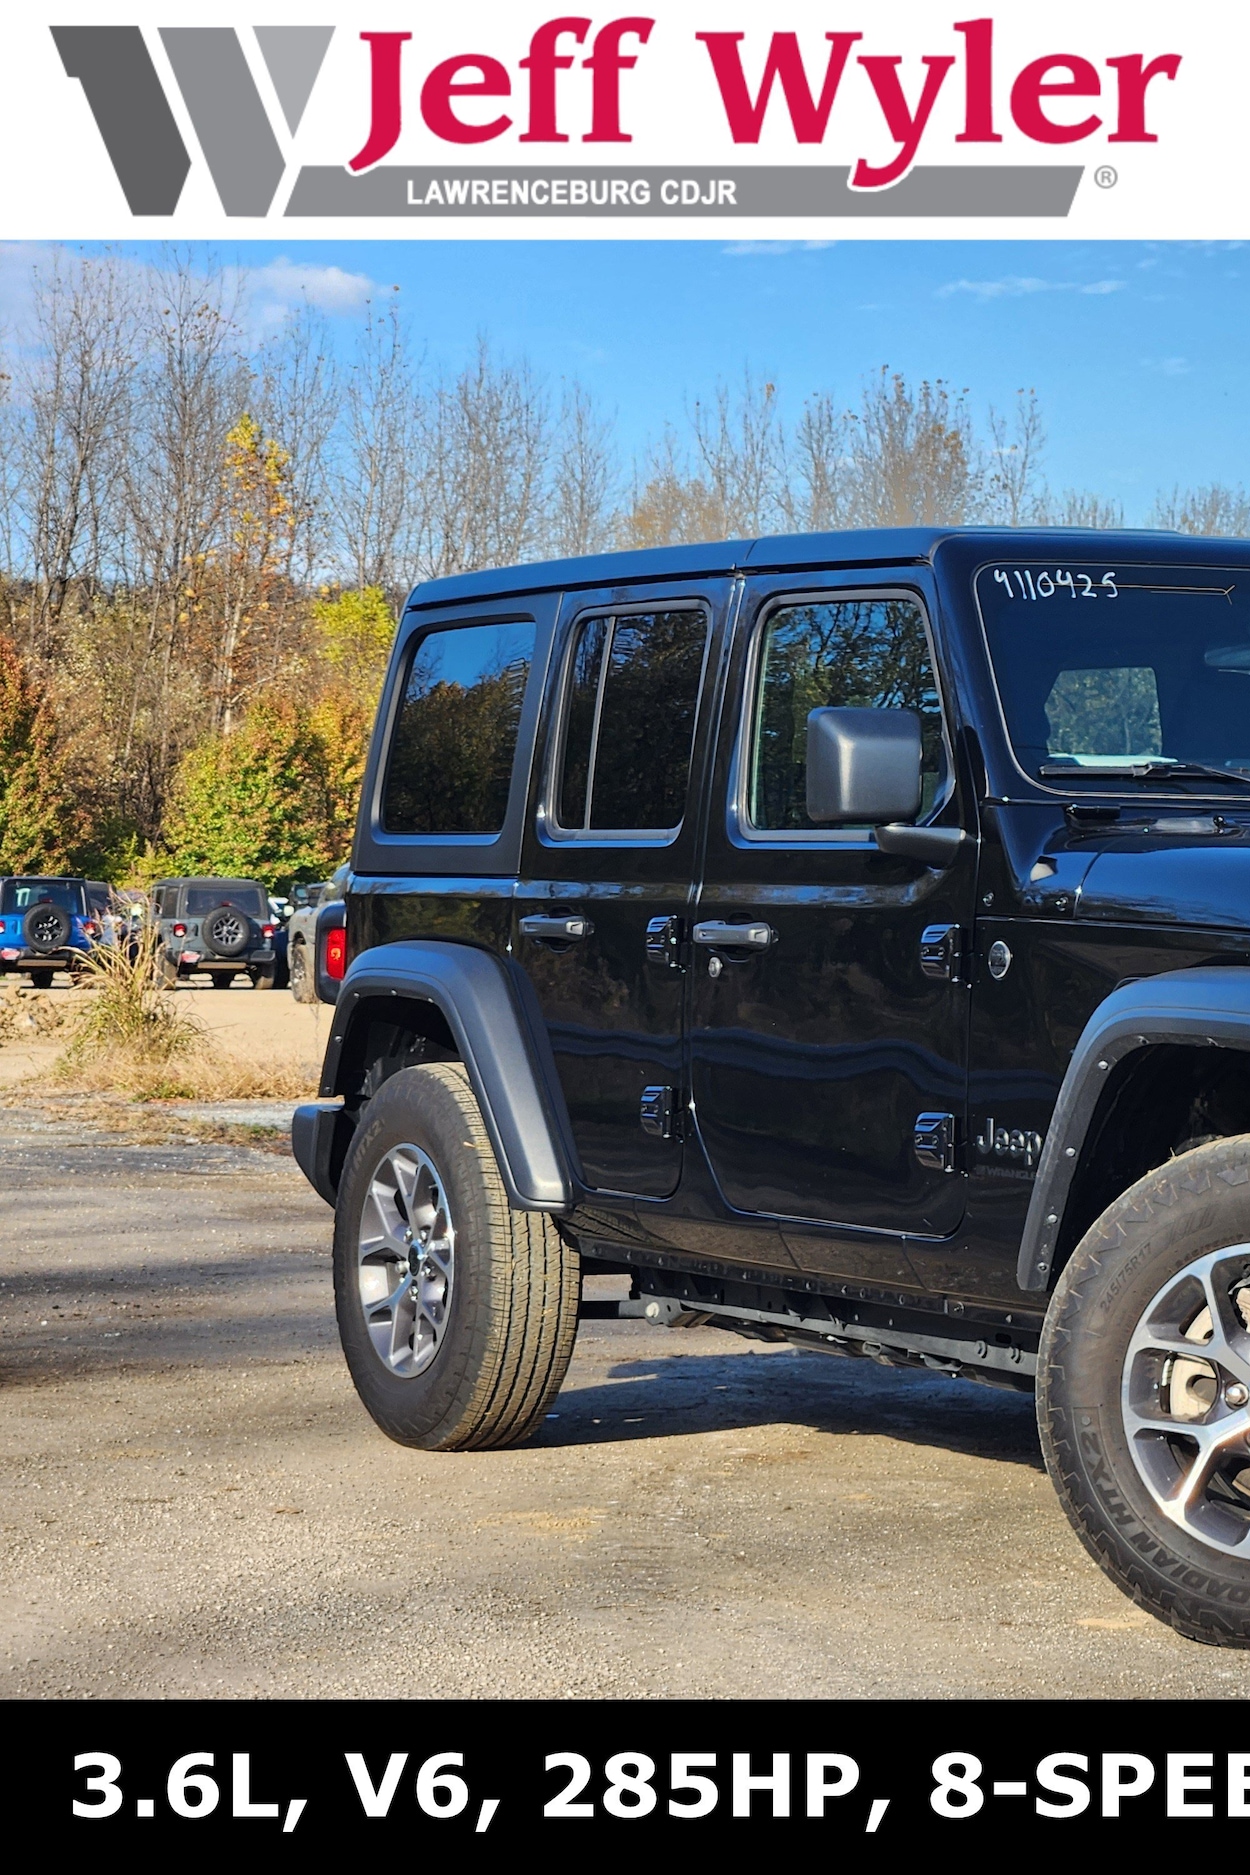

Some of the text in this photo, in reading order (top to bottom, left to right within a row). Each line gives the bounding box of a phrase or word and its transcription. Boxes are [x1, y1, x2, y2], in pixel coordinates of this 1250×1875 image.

[977, 1117, 1042, 1167] Jeep
[1100, 1242, 1153, 1315] 245/75R17
[1080, 1431, 1137, 1527] HTX2
